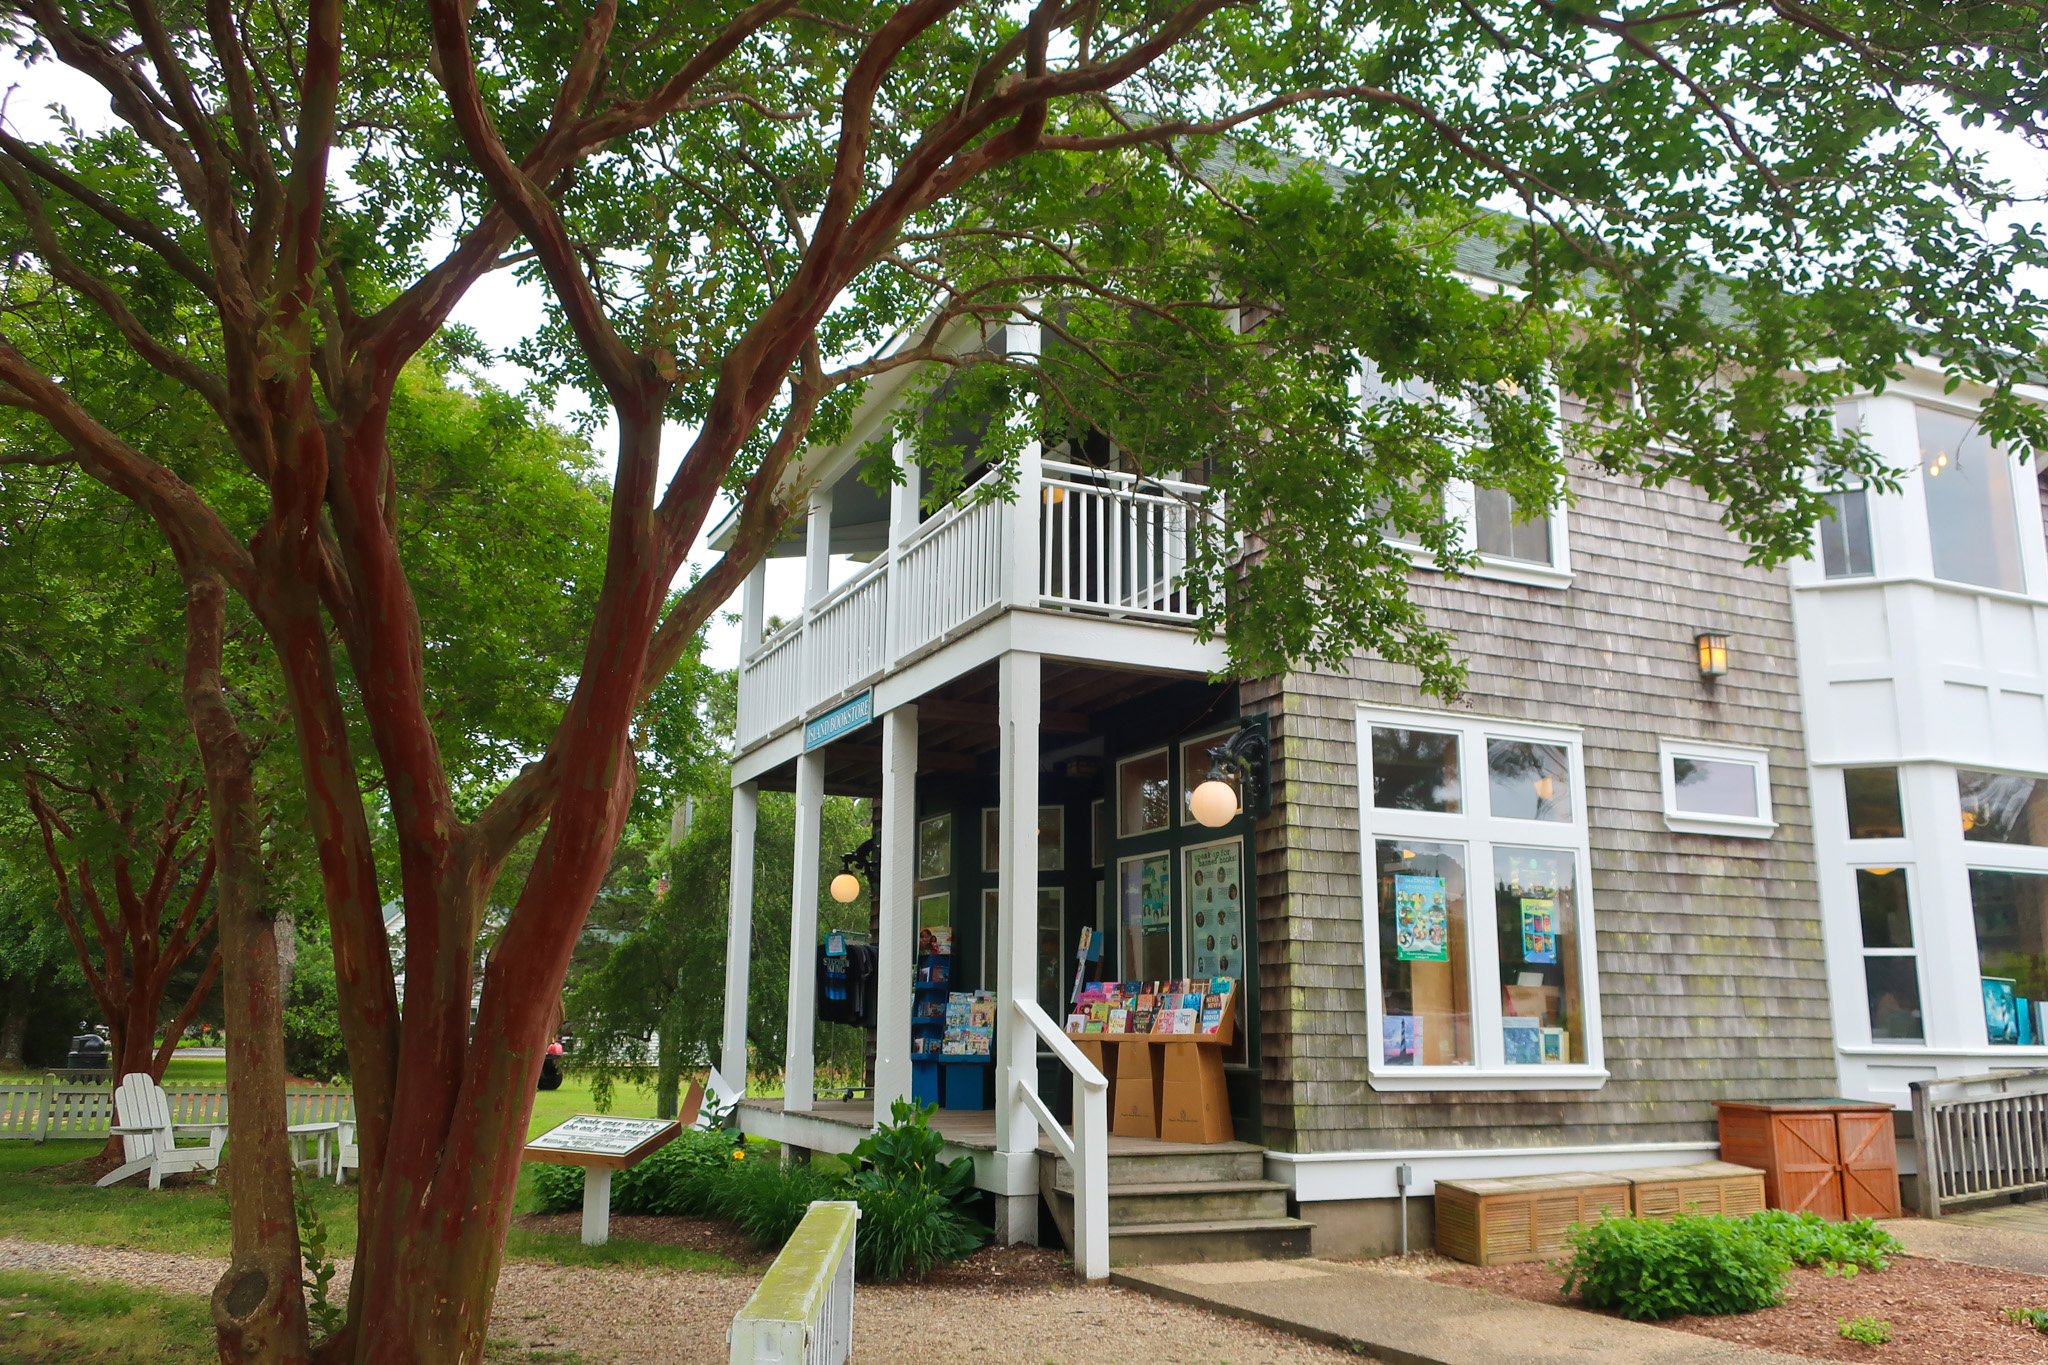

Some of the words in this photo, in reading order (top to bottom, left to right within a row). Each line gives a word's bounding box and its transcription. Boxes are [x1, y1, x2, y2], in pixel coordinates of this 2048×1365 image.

[808, 720, 830, 742] ISLAND
[830, 700, 868, 732] BOOKSTORE
[1220, 848, 1230, 856] for
[828, 964, 846, 974] KING
